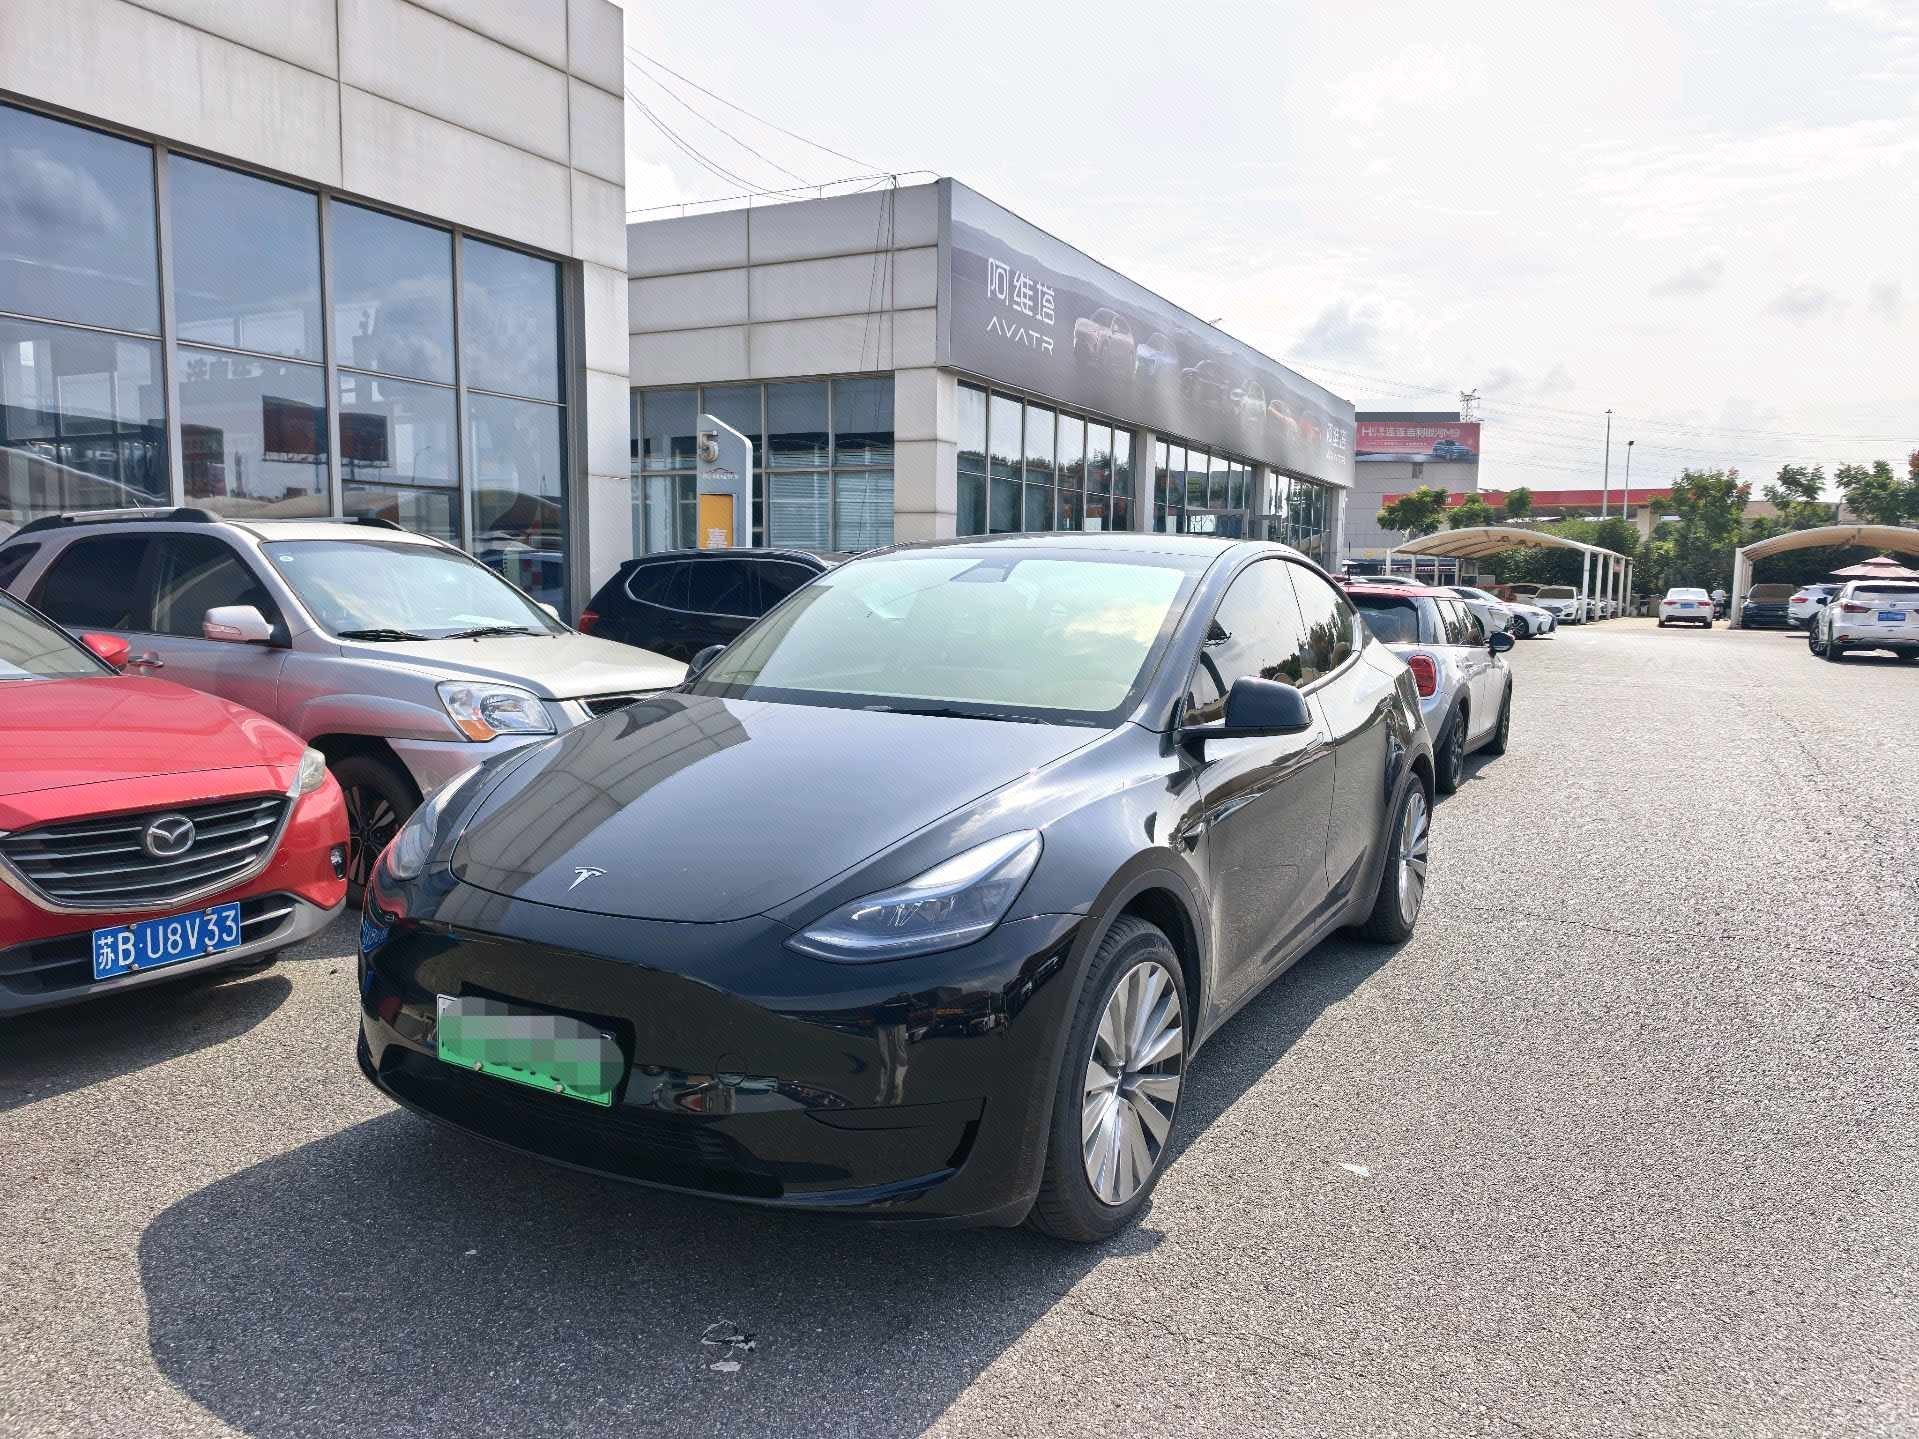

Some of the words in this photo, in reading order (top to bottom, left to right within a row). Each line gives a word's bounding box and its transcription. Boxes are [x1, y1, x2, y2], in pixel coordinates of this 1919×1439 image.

[987, 258, 1054, 325] 阿维塔
[986, 316, 1054, 356] AVATR
